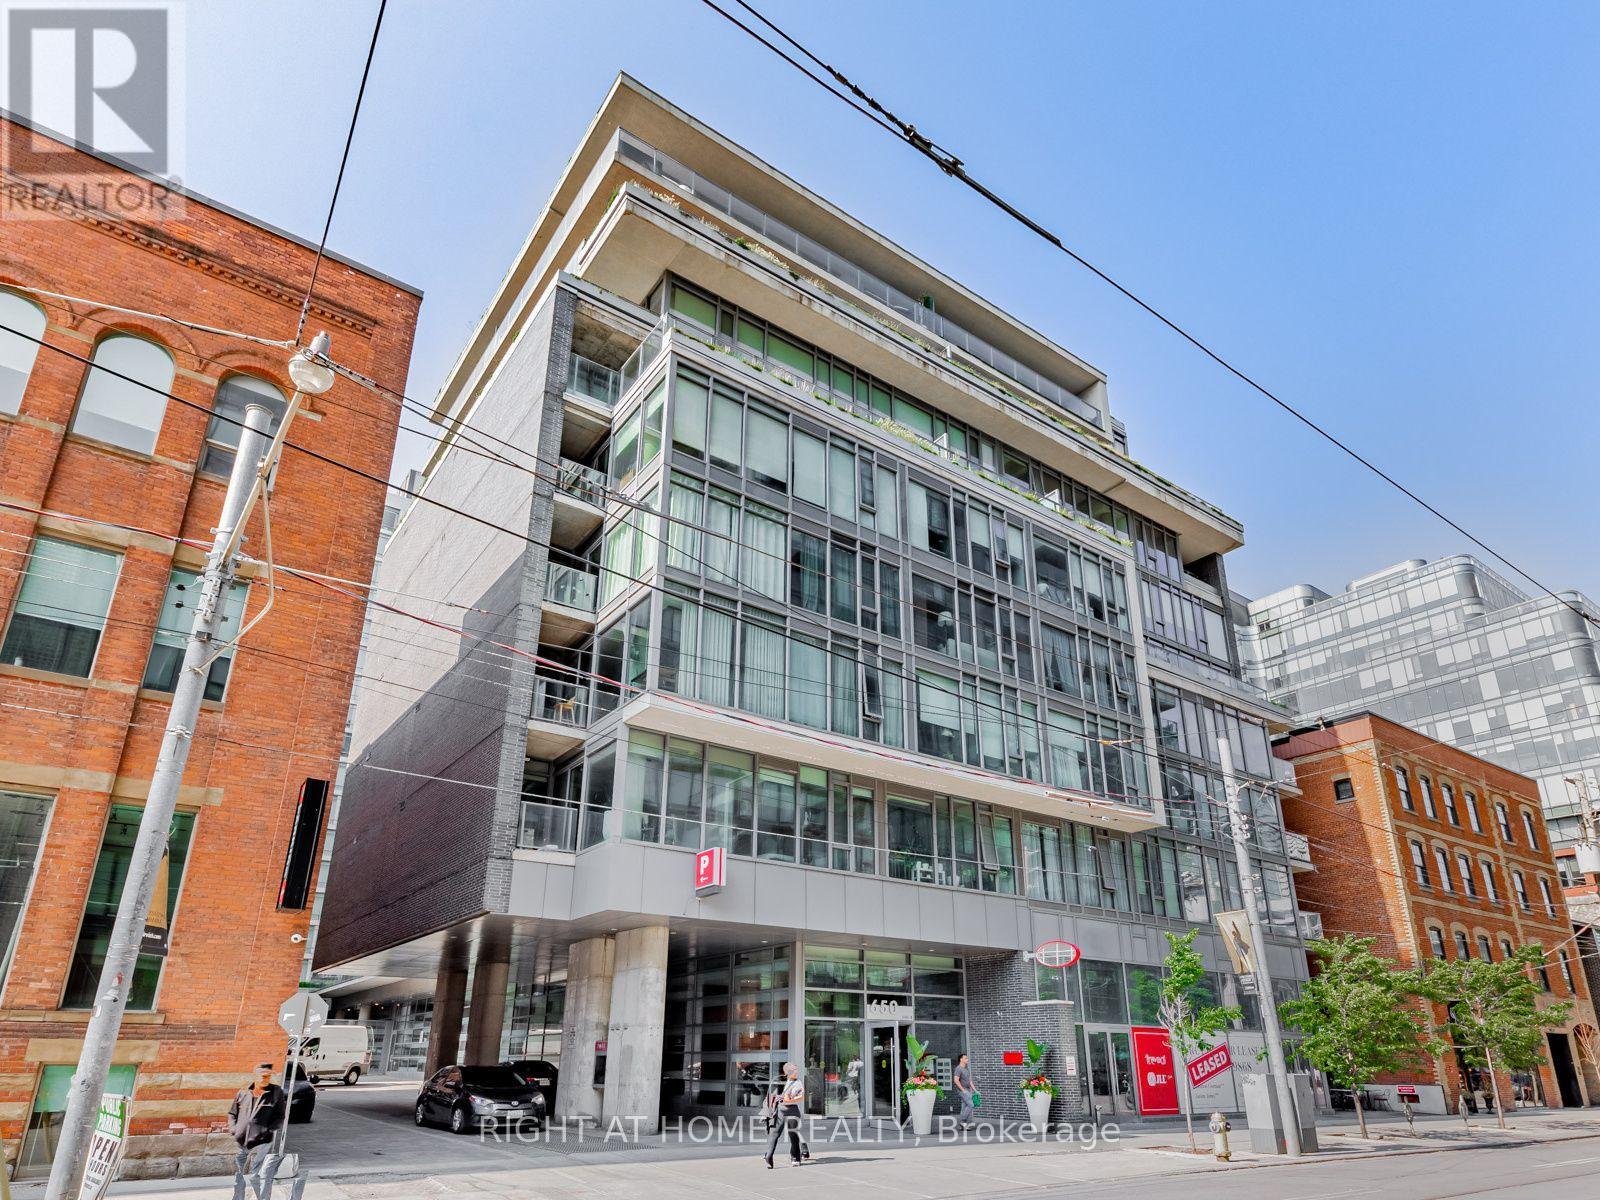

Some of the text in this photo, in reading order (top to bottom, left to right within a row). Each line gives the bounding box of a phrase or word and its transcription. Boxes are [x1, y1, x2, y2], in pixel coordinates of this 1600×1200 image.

[700, 855, 709, 875] P
[870, 999, 898, 1016] 650
[1191, 1050, 1228, 1080] LEASED
